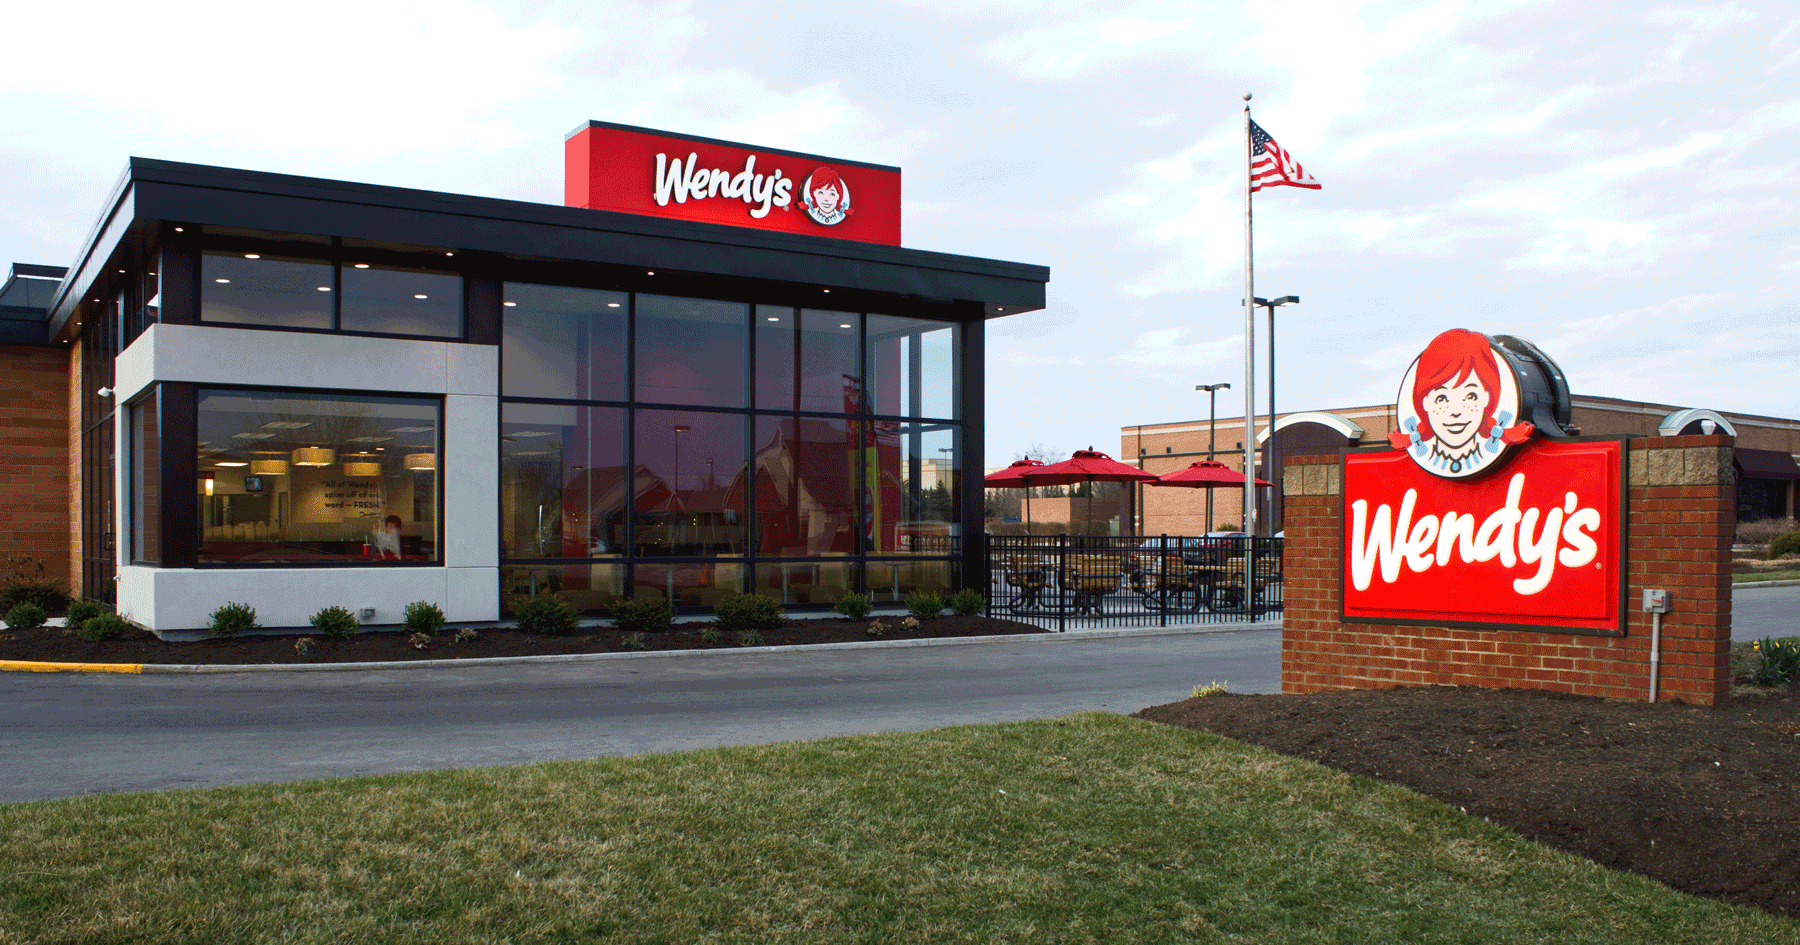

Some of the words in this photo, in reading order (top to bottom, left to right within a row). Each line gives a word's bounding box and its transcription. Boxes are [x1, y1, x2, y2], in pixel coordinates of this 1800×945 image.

[655, 152, 792, 218] Wendy's
[346, 490, 357, 498] off
[358, 490, 367, 498] of
[1351, 472, 1601, 595] Wendy's
